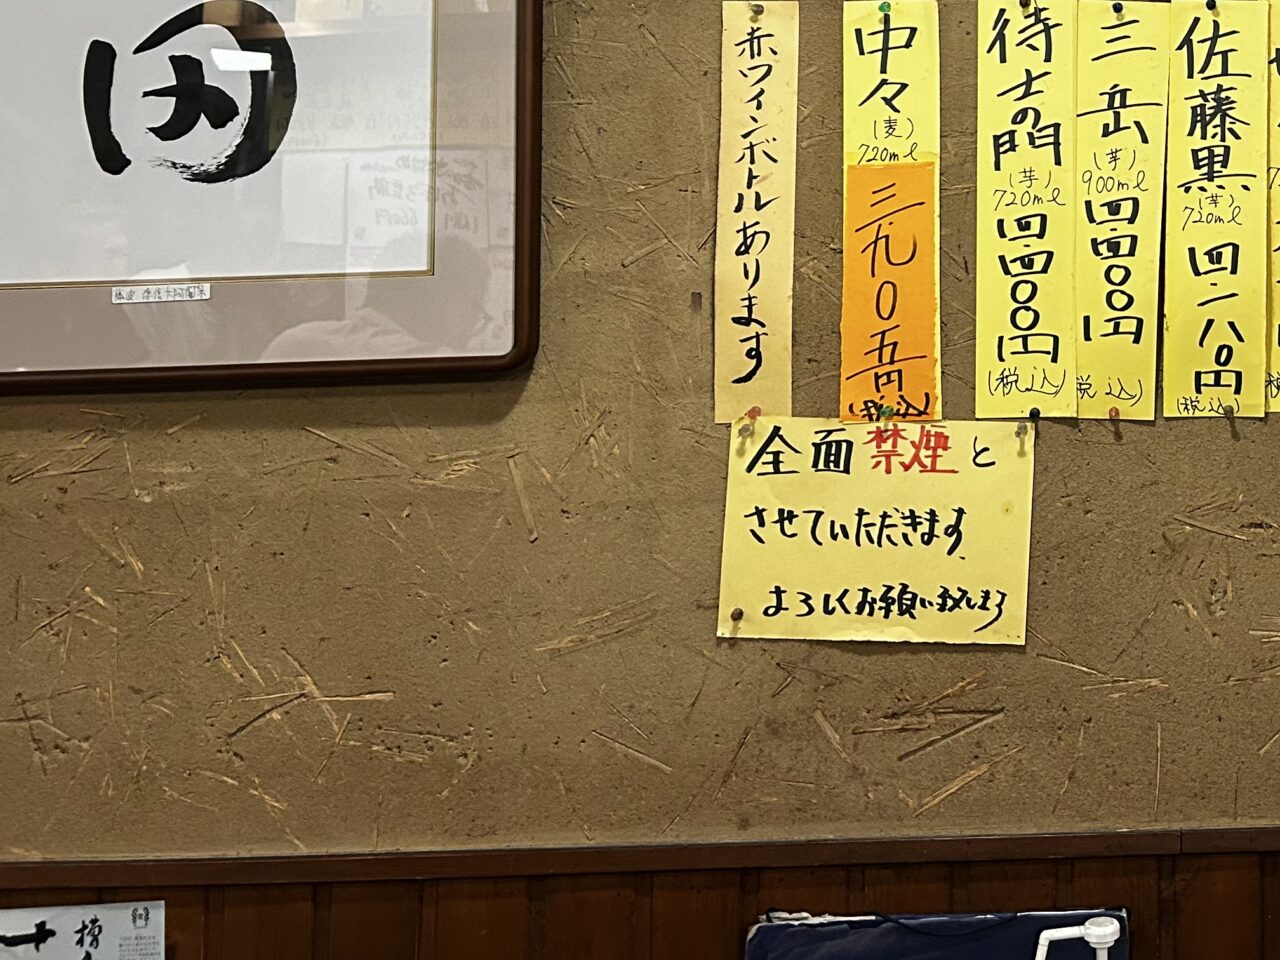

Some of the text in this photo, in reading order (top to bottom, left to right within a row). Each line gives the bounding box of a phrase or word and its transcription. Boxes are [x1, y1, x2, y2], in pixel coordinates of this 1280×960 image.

[855, 14, 918, 113] 中々
[1077, 20, 1163, 144] 三岳
[1175, 17, 1256, 193] 佐藤黒
[874, 116, 913, 139] (麦)
[1094, 149, 1135, 171] (芋)
[1010, 167, 1050, 188] (芋)
[731, 27, 778, 384] 赤ワインボトルあります
[1199, 194, 1234, 209] (芋)
[989, 367, 1065, 397] (税込)
